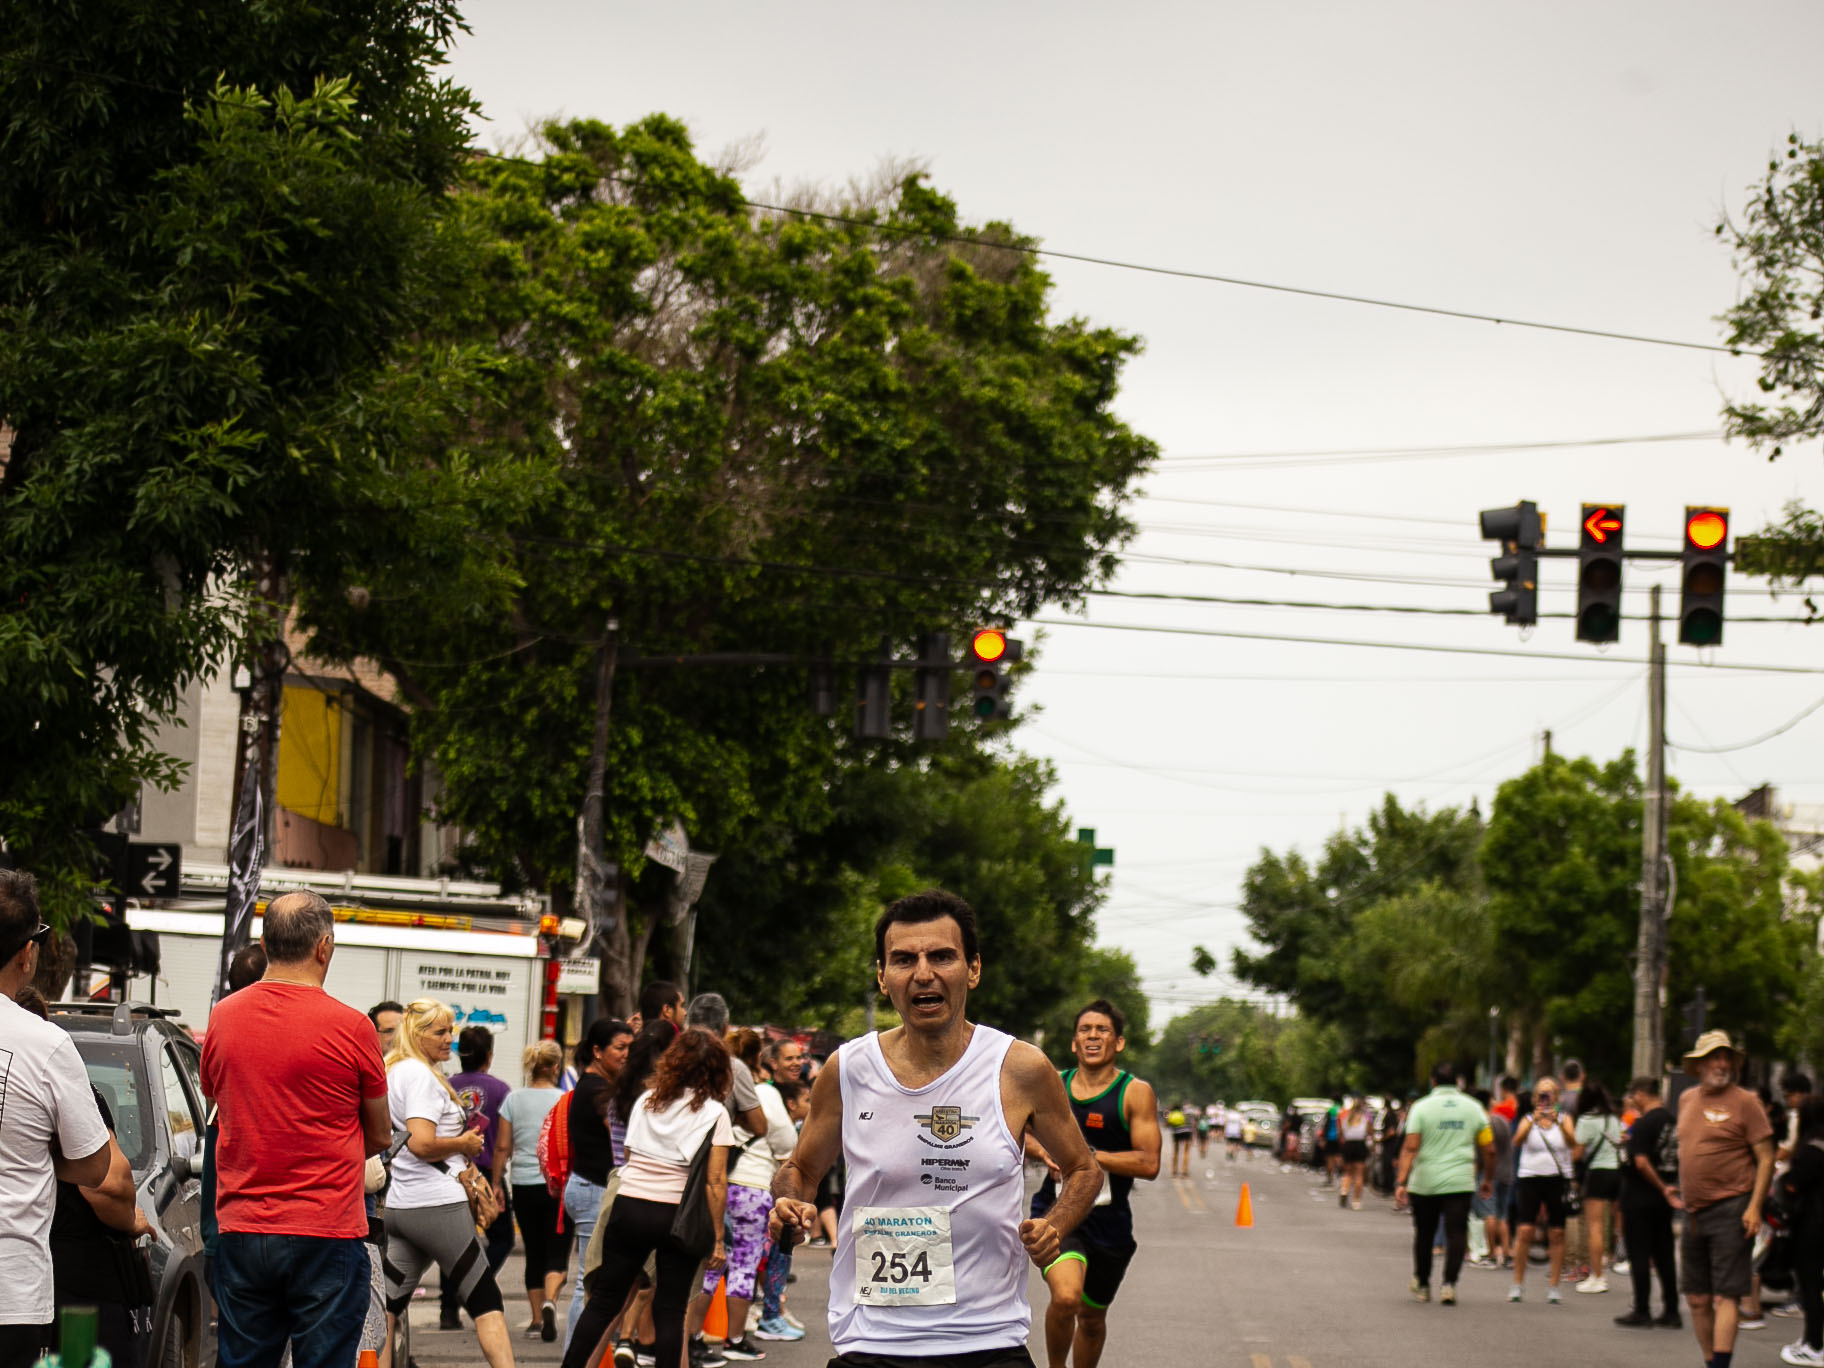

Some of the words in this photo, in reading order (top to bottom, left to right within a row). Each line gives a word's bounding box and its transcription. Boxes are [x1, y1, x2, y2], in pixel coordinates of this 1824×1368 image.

[455, 967, 464, 978] LA
[427, 980, 460, 991] SIEMPRE
[478, 983, 487, 993] LA
[859, 1112, 874, 1120] NEJ
[937, 1125, 955, 1136] 40
[917, 1134, 943, 1149] EMPALME
[944, 1136, 974, 1149] GRANEROS
[935, 1177, 957, 1185] Banco
[934, 1184, 969, 1192] Municipal
[865, 1217, 875, 1226] 40
[878, 1216, 933, 1226] MARATON
[895, 1229, 937, 1237] GRANEROS
[871, 1250, 933, 1284] 254
[860, 1286, 873, 1296] NEJ
